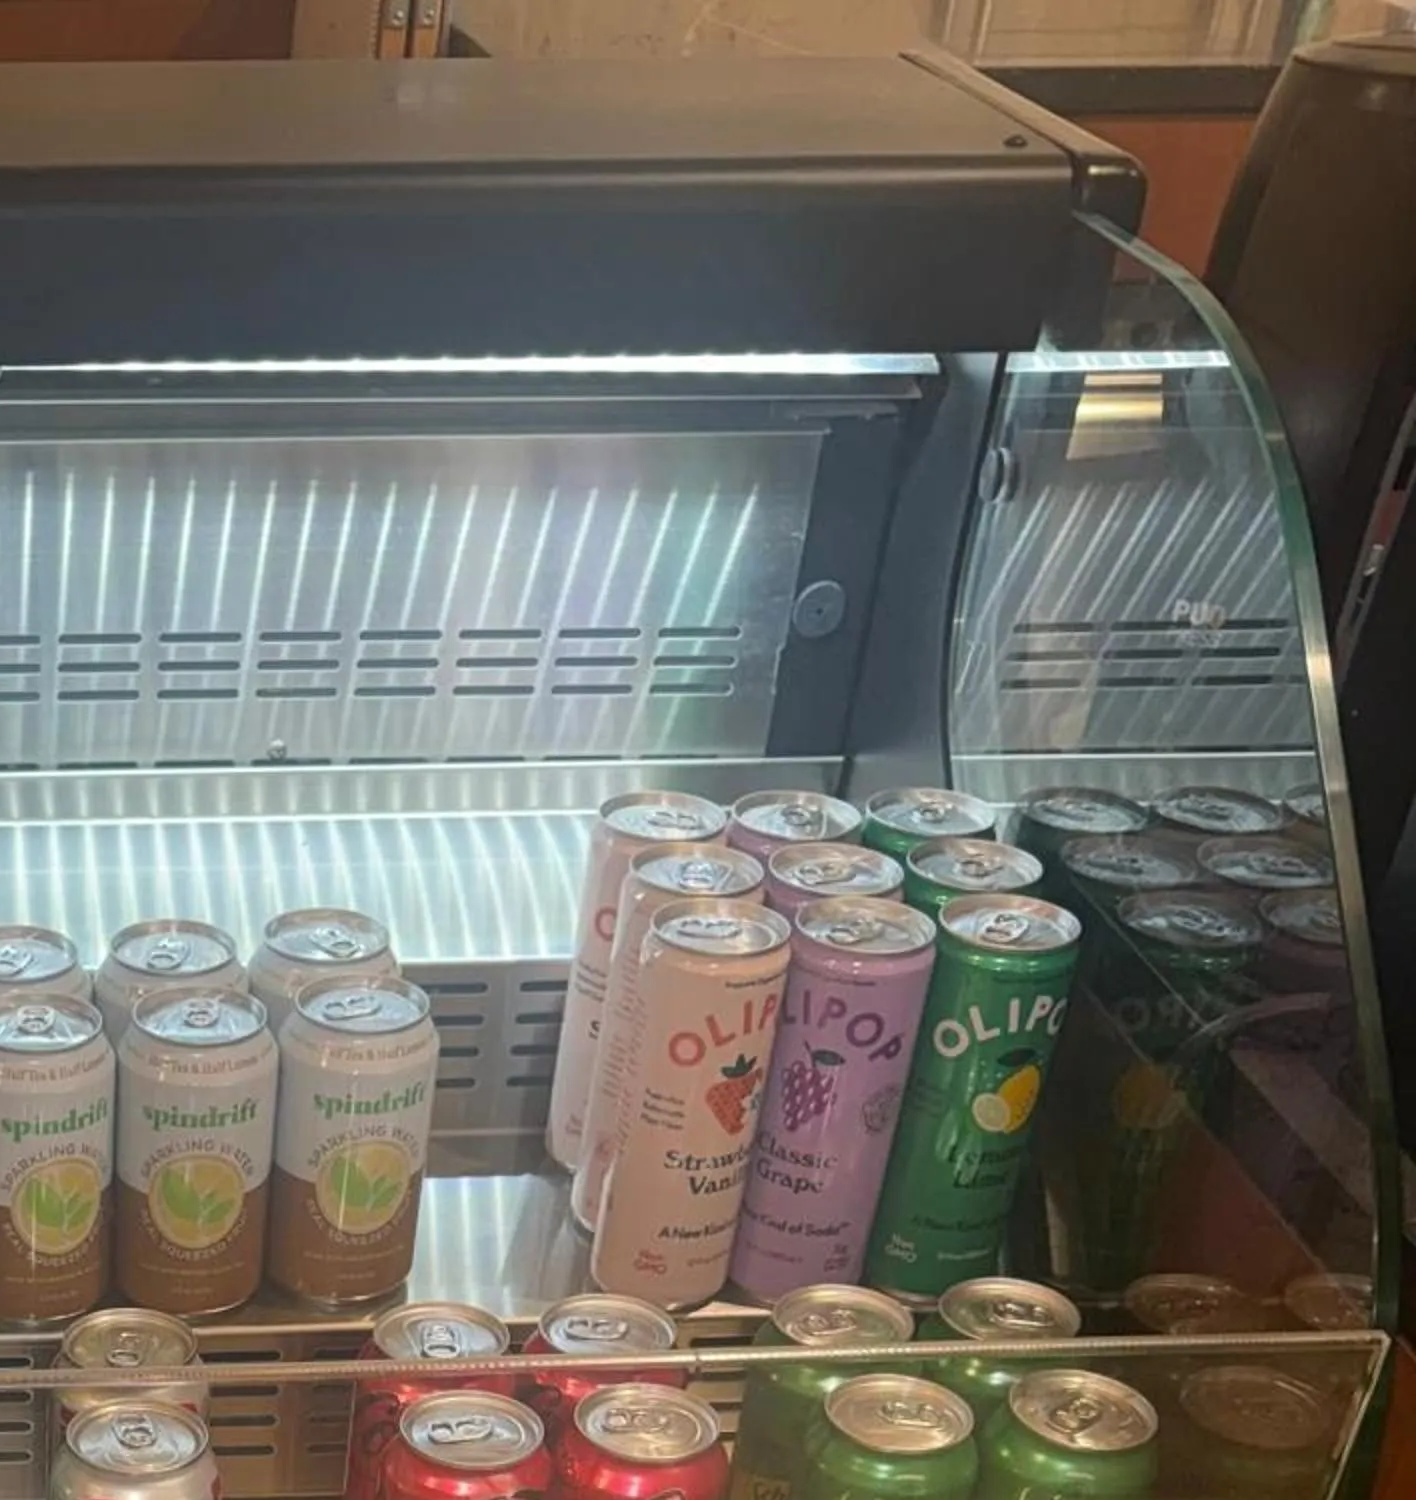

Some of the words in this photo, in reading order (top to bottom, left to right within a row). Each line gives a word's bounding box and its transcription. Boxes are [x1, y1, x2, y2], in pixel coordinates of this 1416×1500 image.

[142, 1097, 258, 1132] spindrift
[314, 1081, 425, 1121] spindrift
[756, 1158, 825, 1194] Grape
